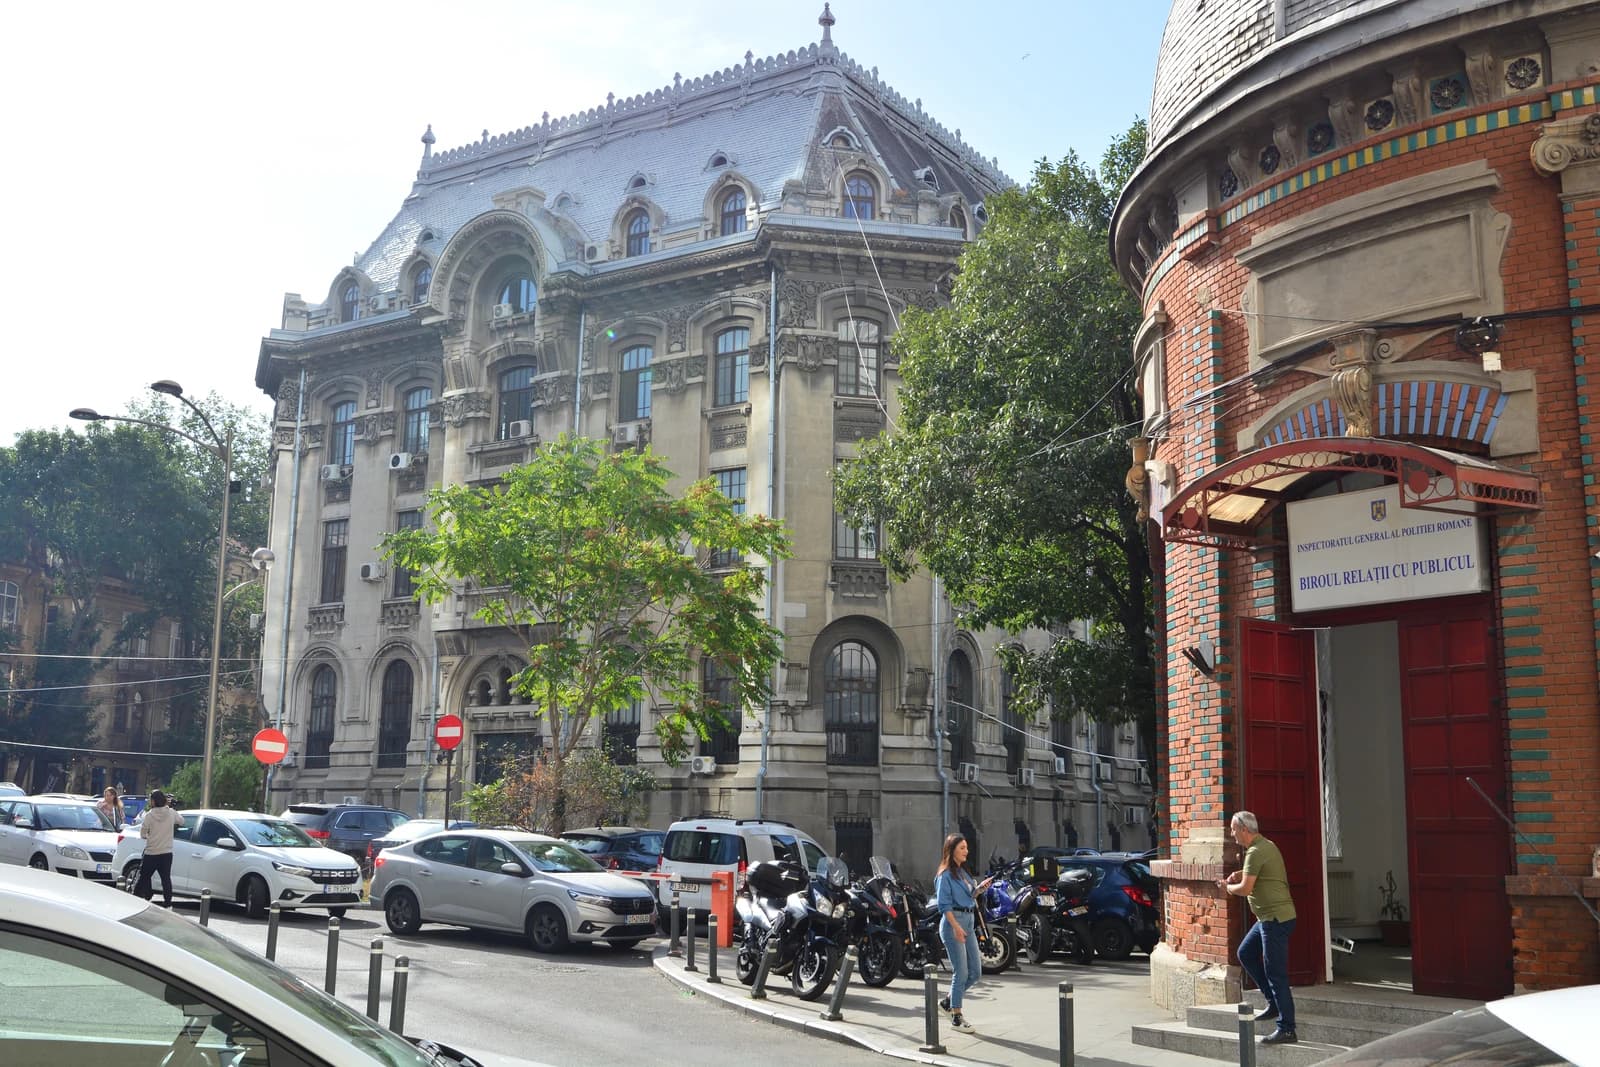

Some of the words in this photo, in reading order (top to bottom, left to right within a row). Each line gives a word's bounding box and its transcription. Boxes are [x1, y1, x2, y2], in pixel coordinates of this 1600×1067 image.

[1297, 536, 1353, 552] INSPECTORATUL
[1354, 529, 1390, 544] GENERAL
[1390, 529, 1401, 540] AL
[1299, 574, 1341, 591] BIROUL
[1392, 563, 1410, 579] CU
[1412, 554, 1475, 576] PUBLICUL
